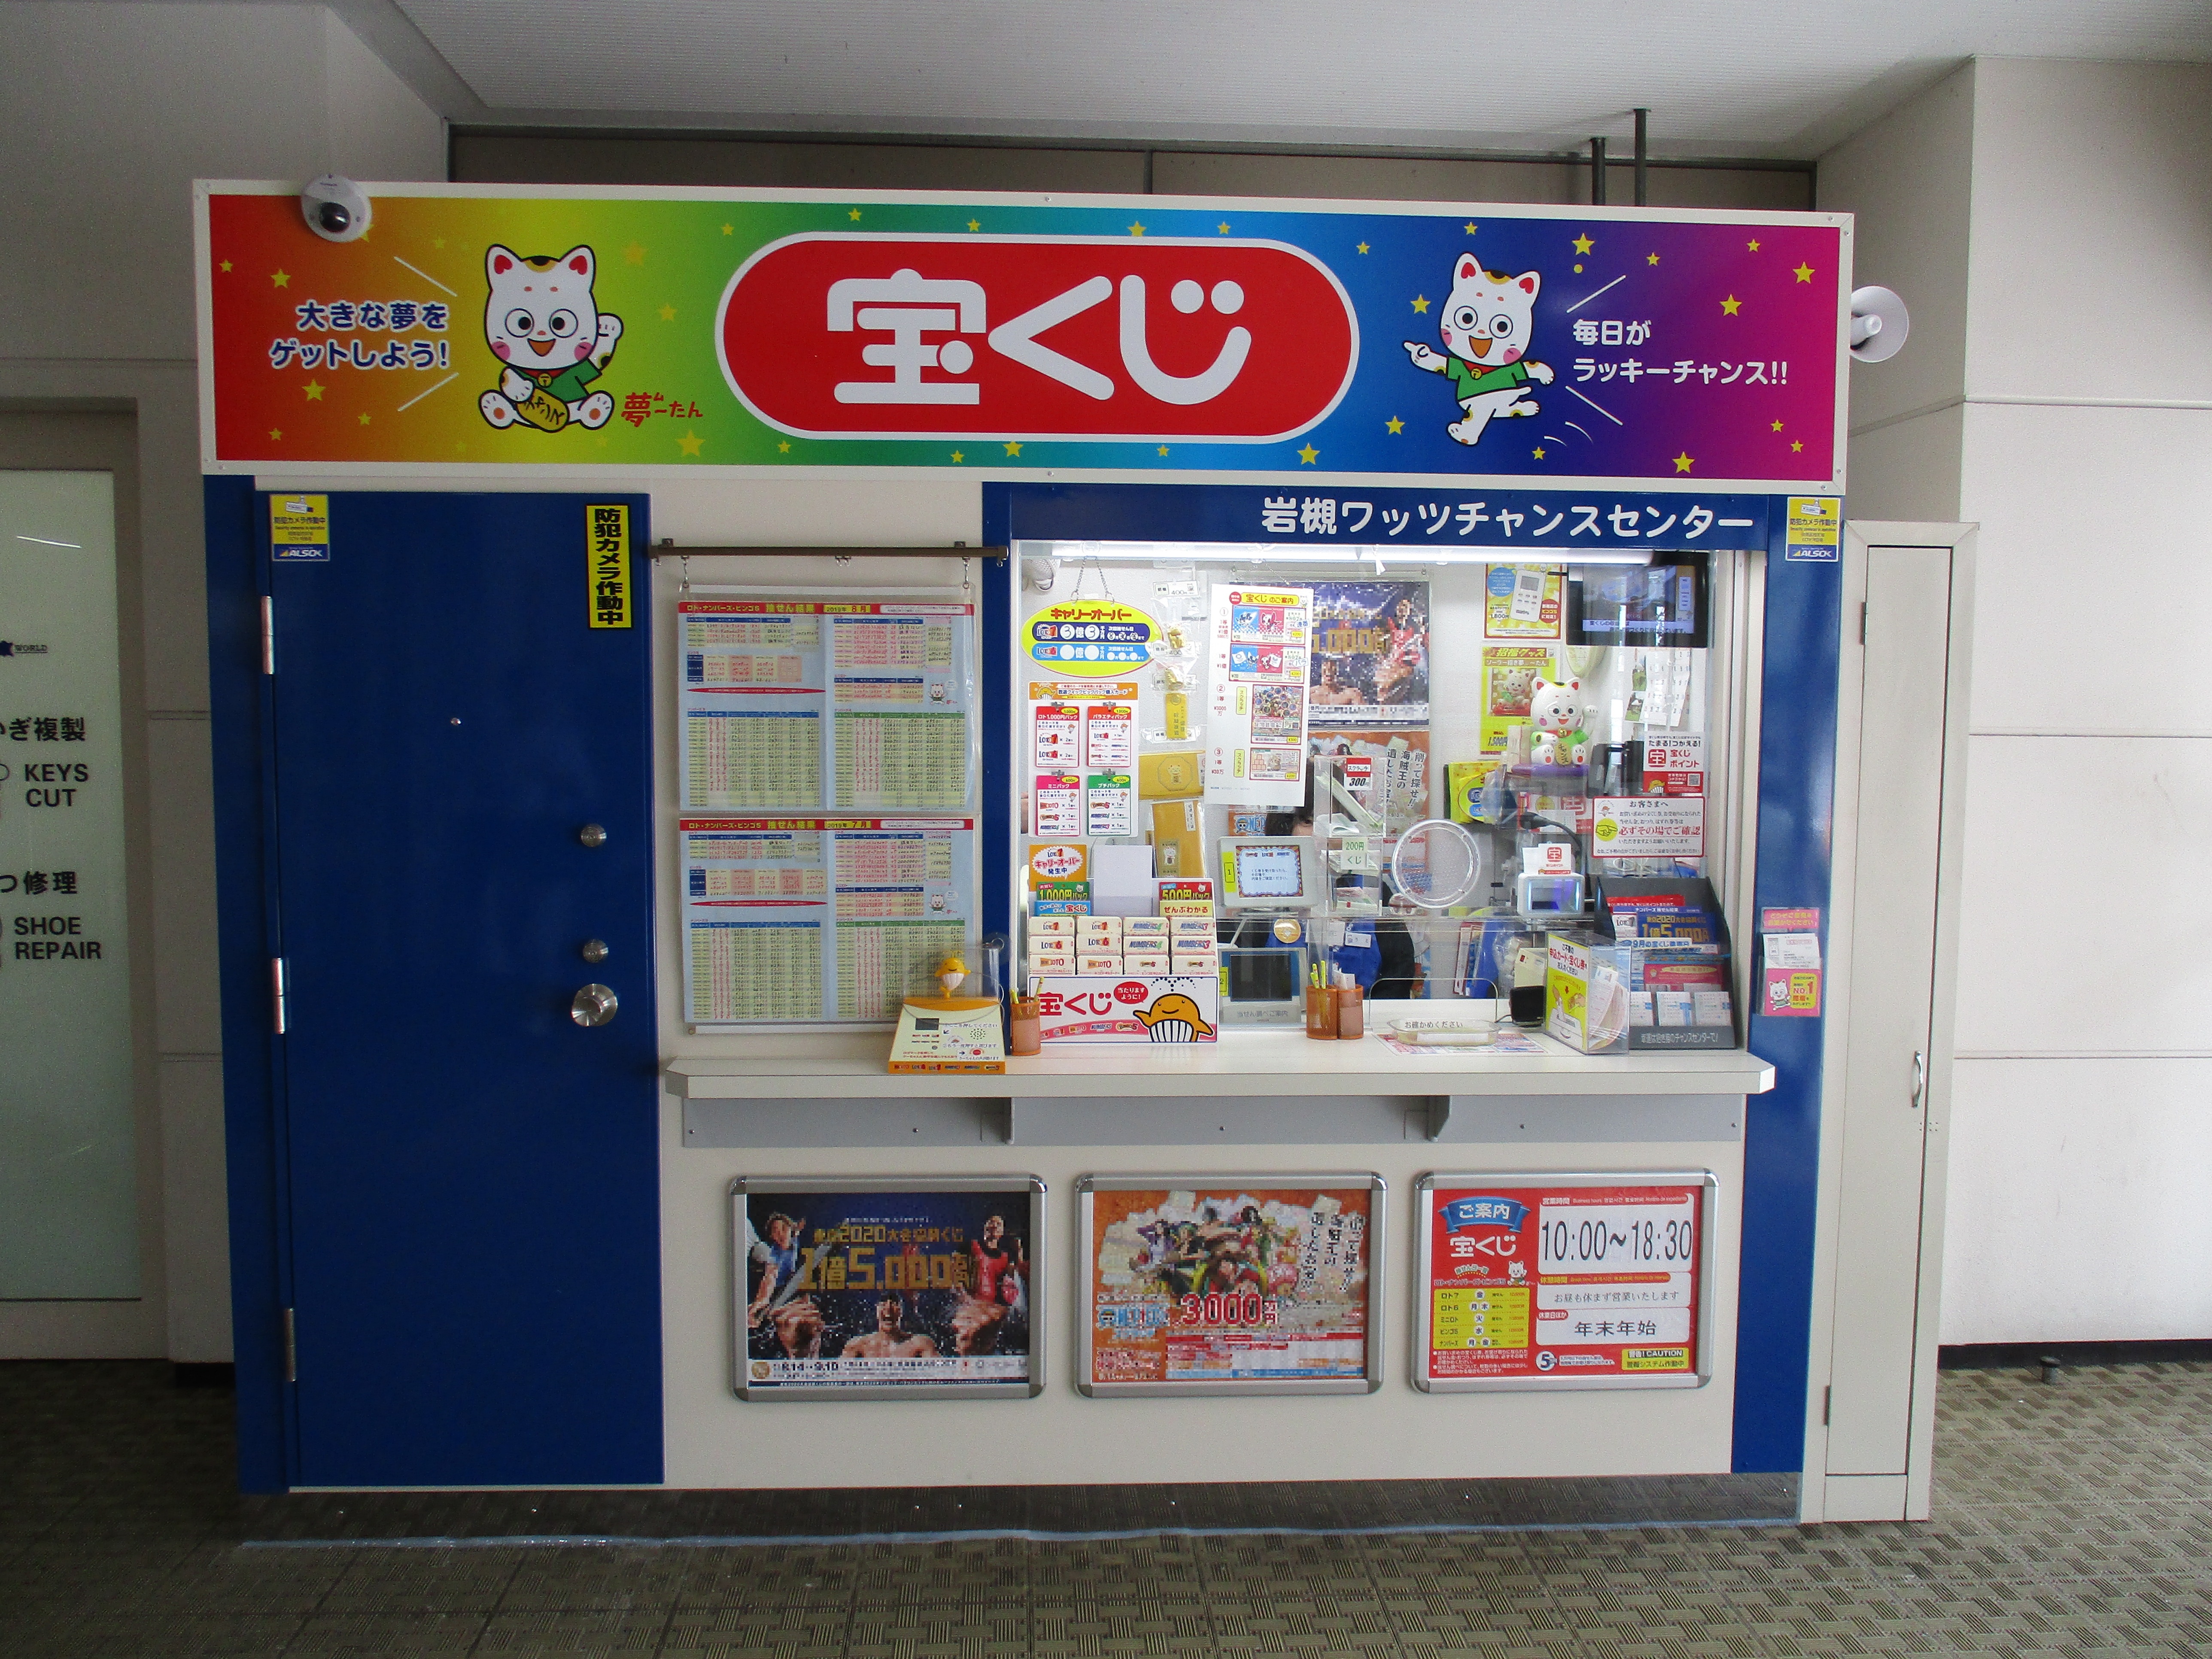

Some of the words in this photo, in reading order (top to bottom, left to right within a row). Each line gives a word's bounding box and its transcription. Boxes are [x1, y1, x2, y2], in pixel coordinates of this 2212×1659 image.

[296, 298, 449, 331] 大きな夢を
[826, 268, 1252, 405] 宝くじ
[1573, 319, 1652, 346] 毎日が
[270, 340, 450, 369] ゲットしよう!
[1573, 358, 1789, 386] ラッキーチャンス!!
[1262, 496, 1753, 538] 岩槻ワッツチャンスセンター
[594, 508, 623, 625] 防犯カメラ作動中
[1246, 594, 1267, 603] 宝くじ
[1051, 608, 1131, 620] キャリーオーバー
[1496, 647, 1545, 657] 招福グッズ
[0, 717, 85, 742] ぎ複製
[24, 763, 88, 783] KEYS
[1397, 750, 1410, 789] 海賊王の
[27, 788, 76, 807] CUT
[1619, 826, 1701, 836] 必ずその場でご確認
[1346, 842, 1364, 851] 200円
[1035, 857, 1081, 868] キャリーオーバー
[1347, 856, 1361, 864] くじ
[1065, 904, 1087, 912] 宝くじ
[15, 916, 82, 935] SHOE
[15, 941, 101, 960] REPAIR
[1039, 992, 1112, 1016] 宝くじ
[1458, 1203, 1510, 1220] ご案内
[1449, 1235, 1516, 1258] 宝くじ
[1555, 1291, 1679, 1302] お昼も休まず営業いたします
[1574, 1320, 1657, 1337] 年末年始
